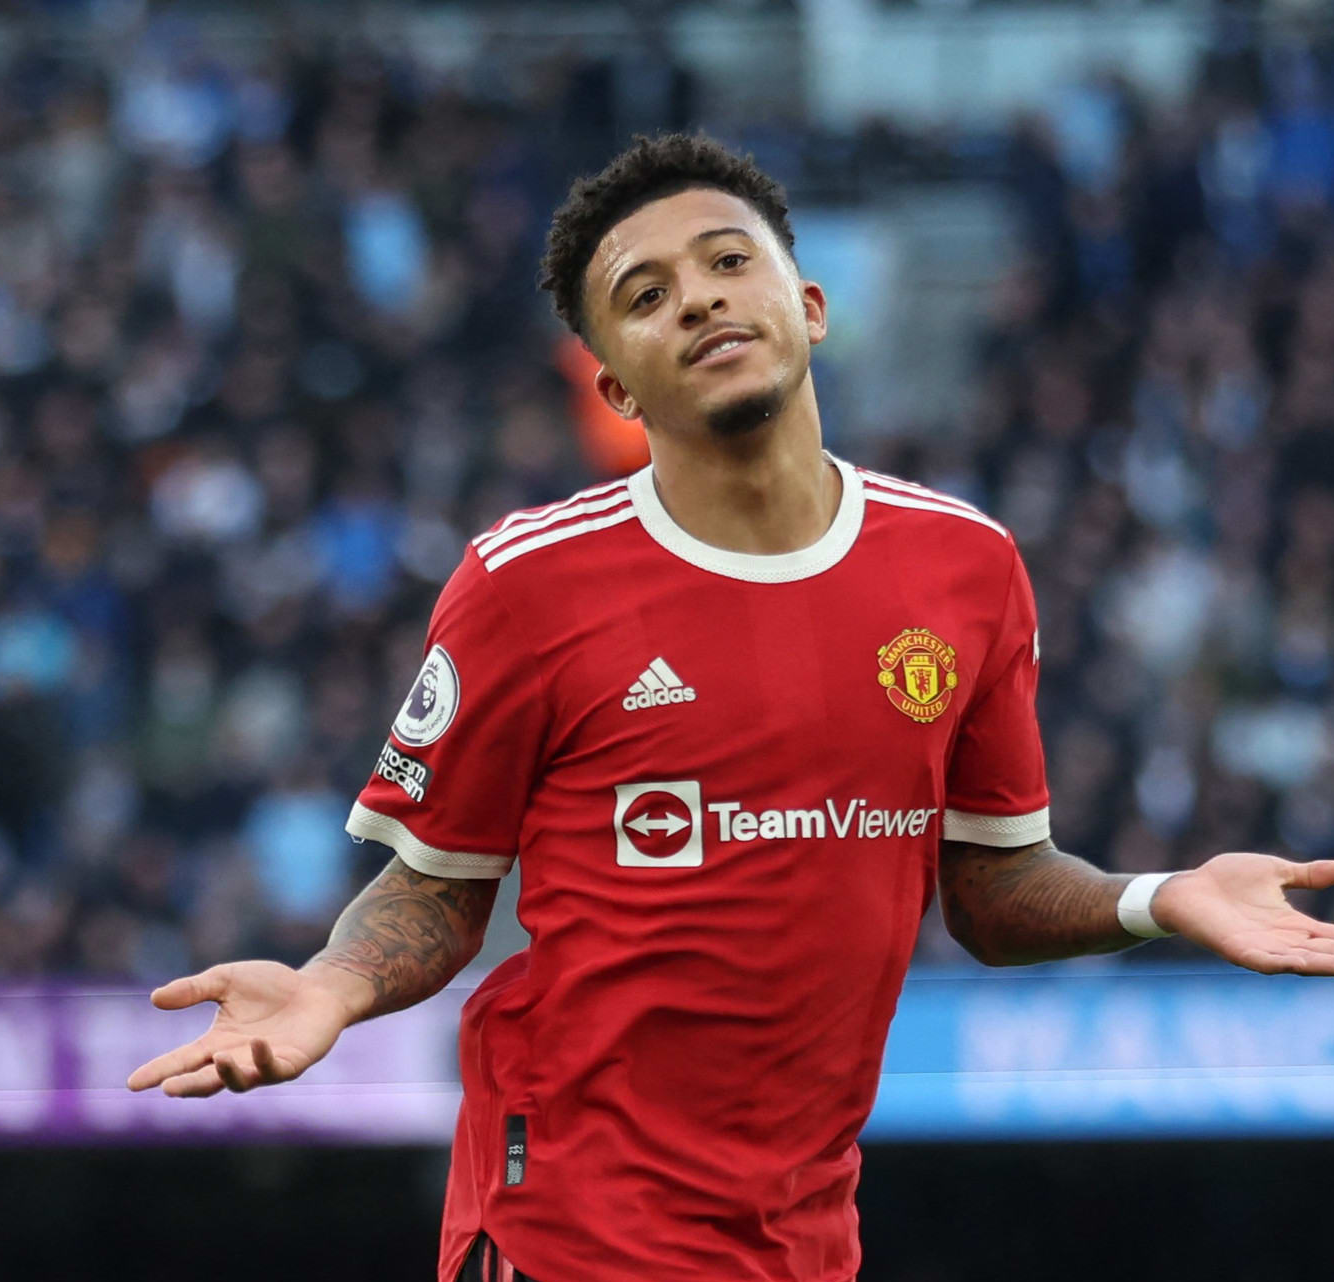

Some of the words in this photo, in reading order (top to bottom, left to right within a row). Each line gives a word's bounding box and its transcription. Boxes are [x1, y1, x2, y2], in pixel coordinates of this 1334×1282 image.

[884, 634, 953, 667] MANCHESTER
[622, 687, 696, 711] adidas
[901, 700, 943, 717] UNITED
[378, 761, 425, 802] racism
[384, 746, 427, 784] room
[707, 798, 938, 842] TeamViewer
